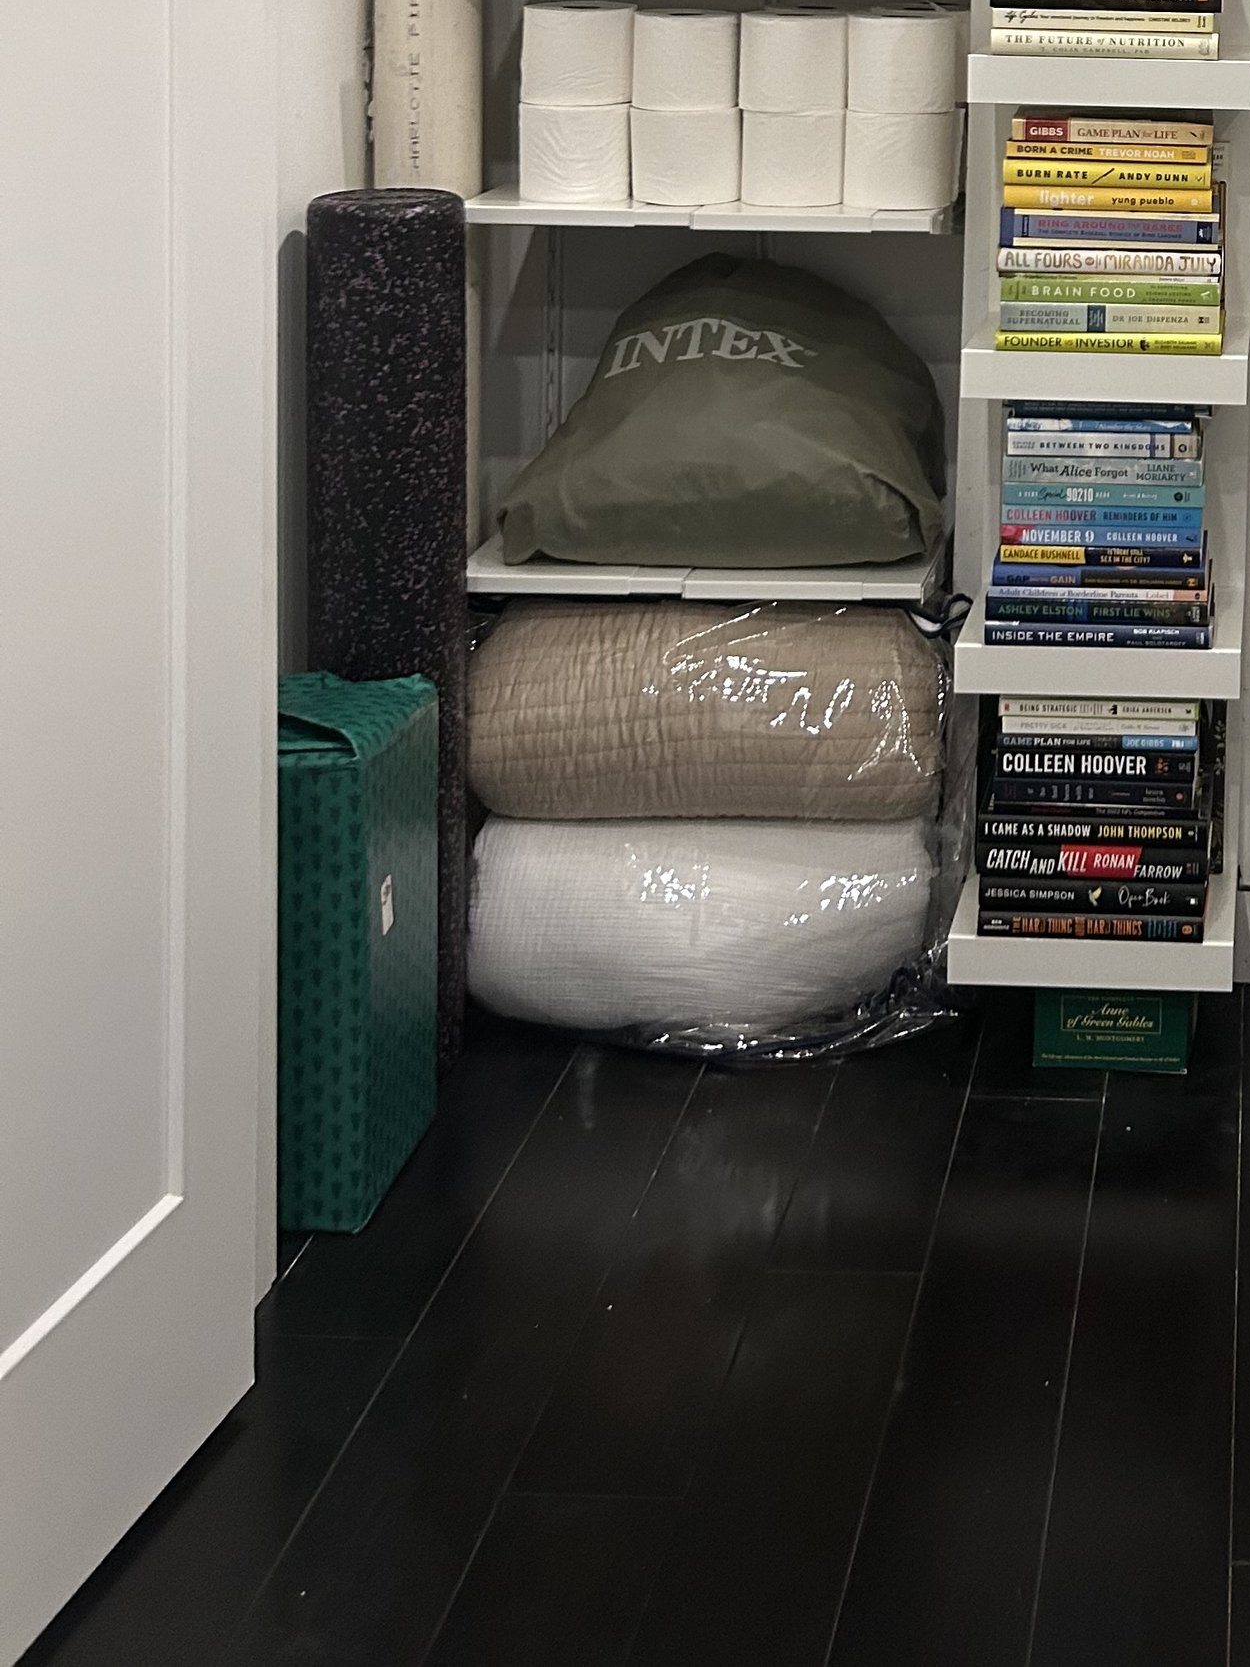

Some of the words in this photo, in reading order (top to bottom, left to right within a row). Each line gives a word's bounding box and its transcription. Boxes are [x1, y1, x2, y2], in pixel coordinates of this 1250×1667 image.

[1006, 35, 1033, 44] THE
[1039, 36, 1093, 45] FUTURE
[1109, 38, 1185, 47] NUTRITION
[1030, 127, 1063, 136] GIBBS
[1078, 128, 1110, 138] GAME
[1112, 128, 1140, 138] PLAN
[1154, 130, 1178, 139] LIFE
[1017, 145, 1046, 153] BORN
[1060, 146, 1093, 155] CRIME
[1099, 148, 1141, 158] TREVOR
[1144, 149, 1175, 158] NOAH
[1017, 169, 1051, 178] BURN
[1057, 170, 1088, 179] RATE
[1119, 172, 1150, 181] ANDY
[1156, 173, 1188, 182] DUNN
[1005, 252, 1030, 267] ALL
[1035, 253, 1082, 268] FOURS
[1104, 254, 1174, 271] MIRANDA
[1178, 256, 1217, 272] JULY
[1032, 286, 1081, 297] BRAIN
[1090, 288, 1136, 298] FOOD
[1004, 336, 1062, 347] FOUNDER
[604, 318, 804, 378] INTEX
[1030, 463, 1059, 473] What
[1060, 465, 1092, 477] Alice
[1095, 467, 1128, 479] Forgot
[1007, 509, 1052, 520] COLLEEN
[1056, 510, 1097, 521] HOOVER
[1022, 529, 1081, 543] NOVEMBER
[1085, 530, 1094, 543] 9
[1107, 532, 1142, 542] COLLEEN
[1003, 548, 1038, 559] CANDACE
[1040, 550, 1081, 560] BUSHNELL
[992, 631, 1033, 640] INSIDE
[1038, 631, 1062, 641] THE
[1068, 632, 1115, 642] EMPIRE
[1034, 737, 1062, 746] PLAN
[1002, 753, 1075, 773] COLLEEN
[1081, 755, 1147, 775] HOOVER
[992, 823, 1018, 835] CAME
[1022, 824, 1035, 835] AS
[1038, 824, 1045, 835] A
[1048, 824, 1091, 837] SHADOW
[1098, 825, 1124, 838] JOHN
[1128, 826, 1182, 840] THOMPSON
[986, 849, 1031, 869] CATCH
[1029, 858, 1055, 875] AND
[1057, 850, 1087, 872] KILL
[1093, 853, 1135, 869] RONAN
[1134, 864, 1183, 879] FARROW
[985, 888, 1027, 898] JESSICA
[1029, 890, 1075, 900] SIMPSON
[1092, 1003, 1129, 1016] Anne
[1067, 1017, 1081, 1028] of
[1082, 1017, 1114, 1028] Green
[1118, 1017, 1153, 1028] Gables
